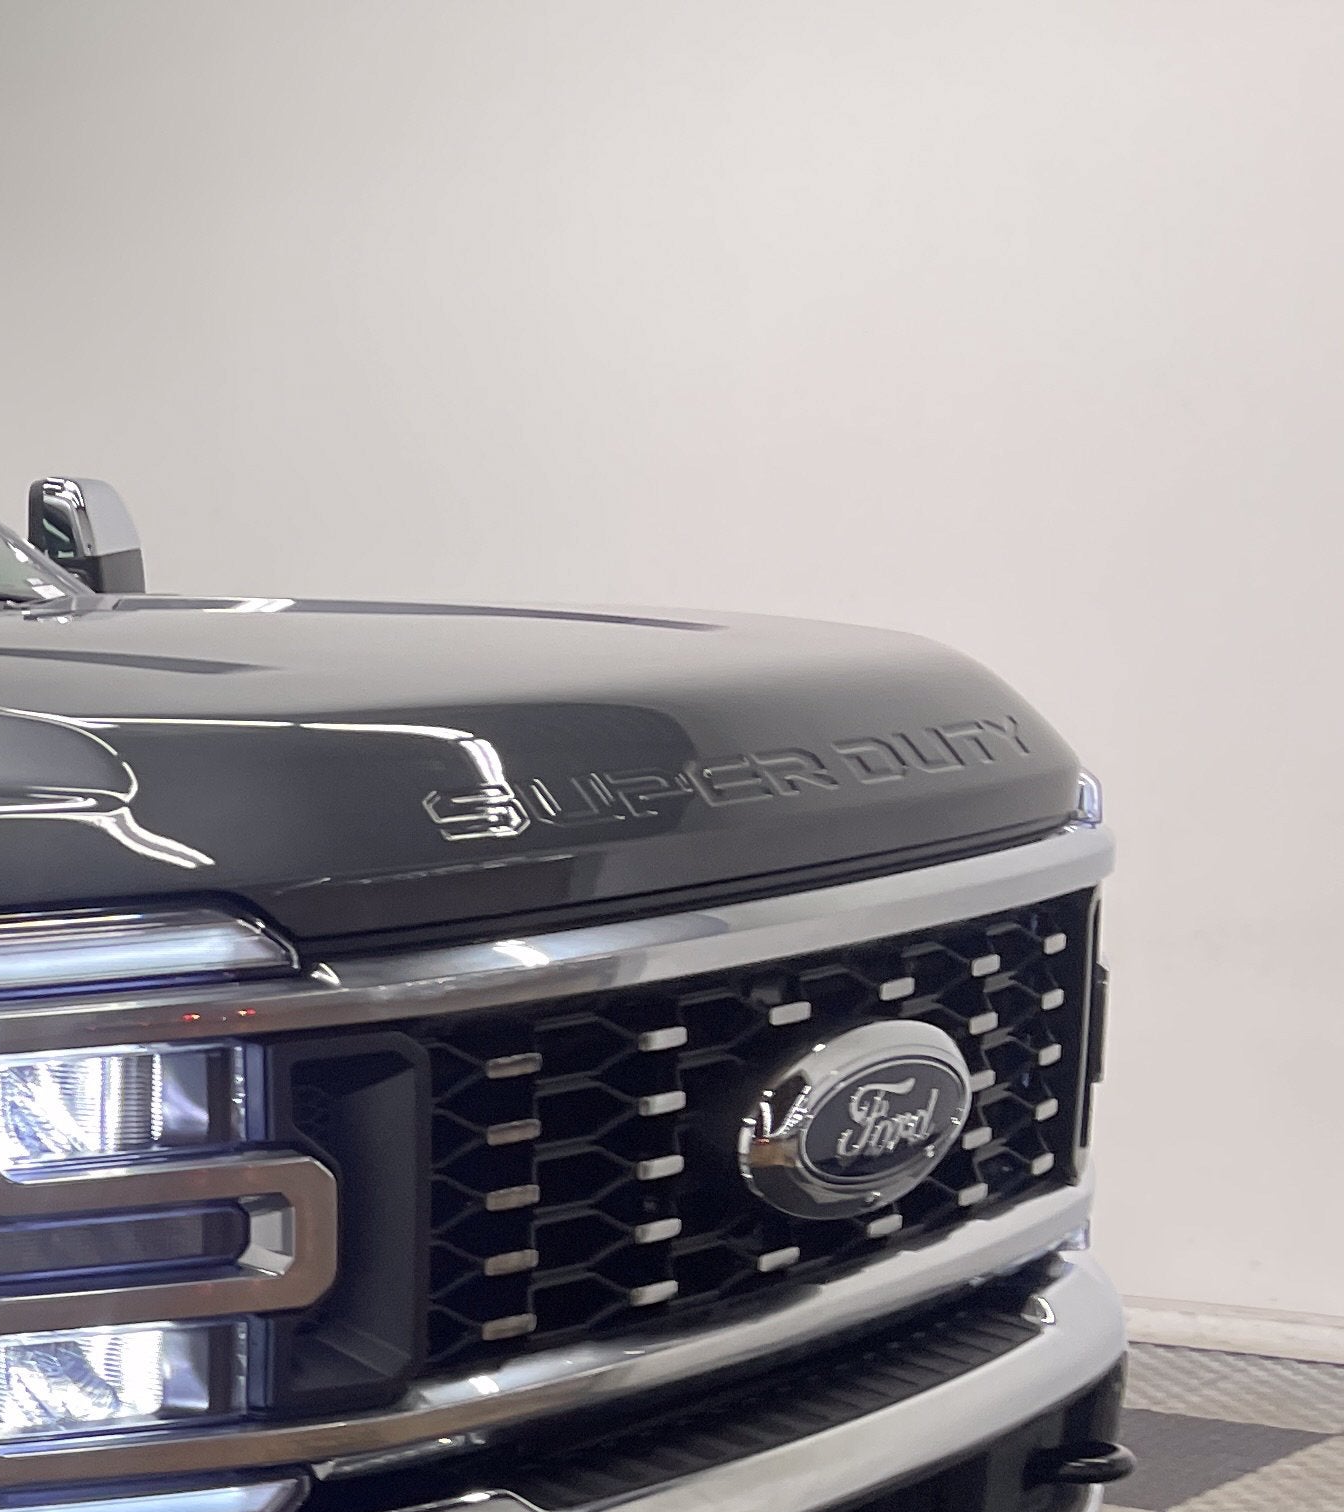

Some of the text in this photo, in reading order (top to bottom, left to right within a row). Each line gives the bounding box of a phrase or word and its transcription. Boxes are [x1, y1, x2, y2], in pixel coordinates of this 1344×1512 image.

[422, 715, 1032, 841] SUPER DUTY
[836, 1077, 939, 1157] Ford
